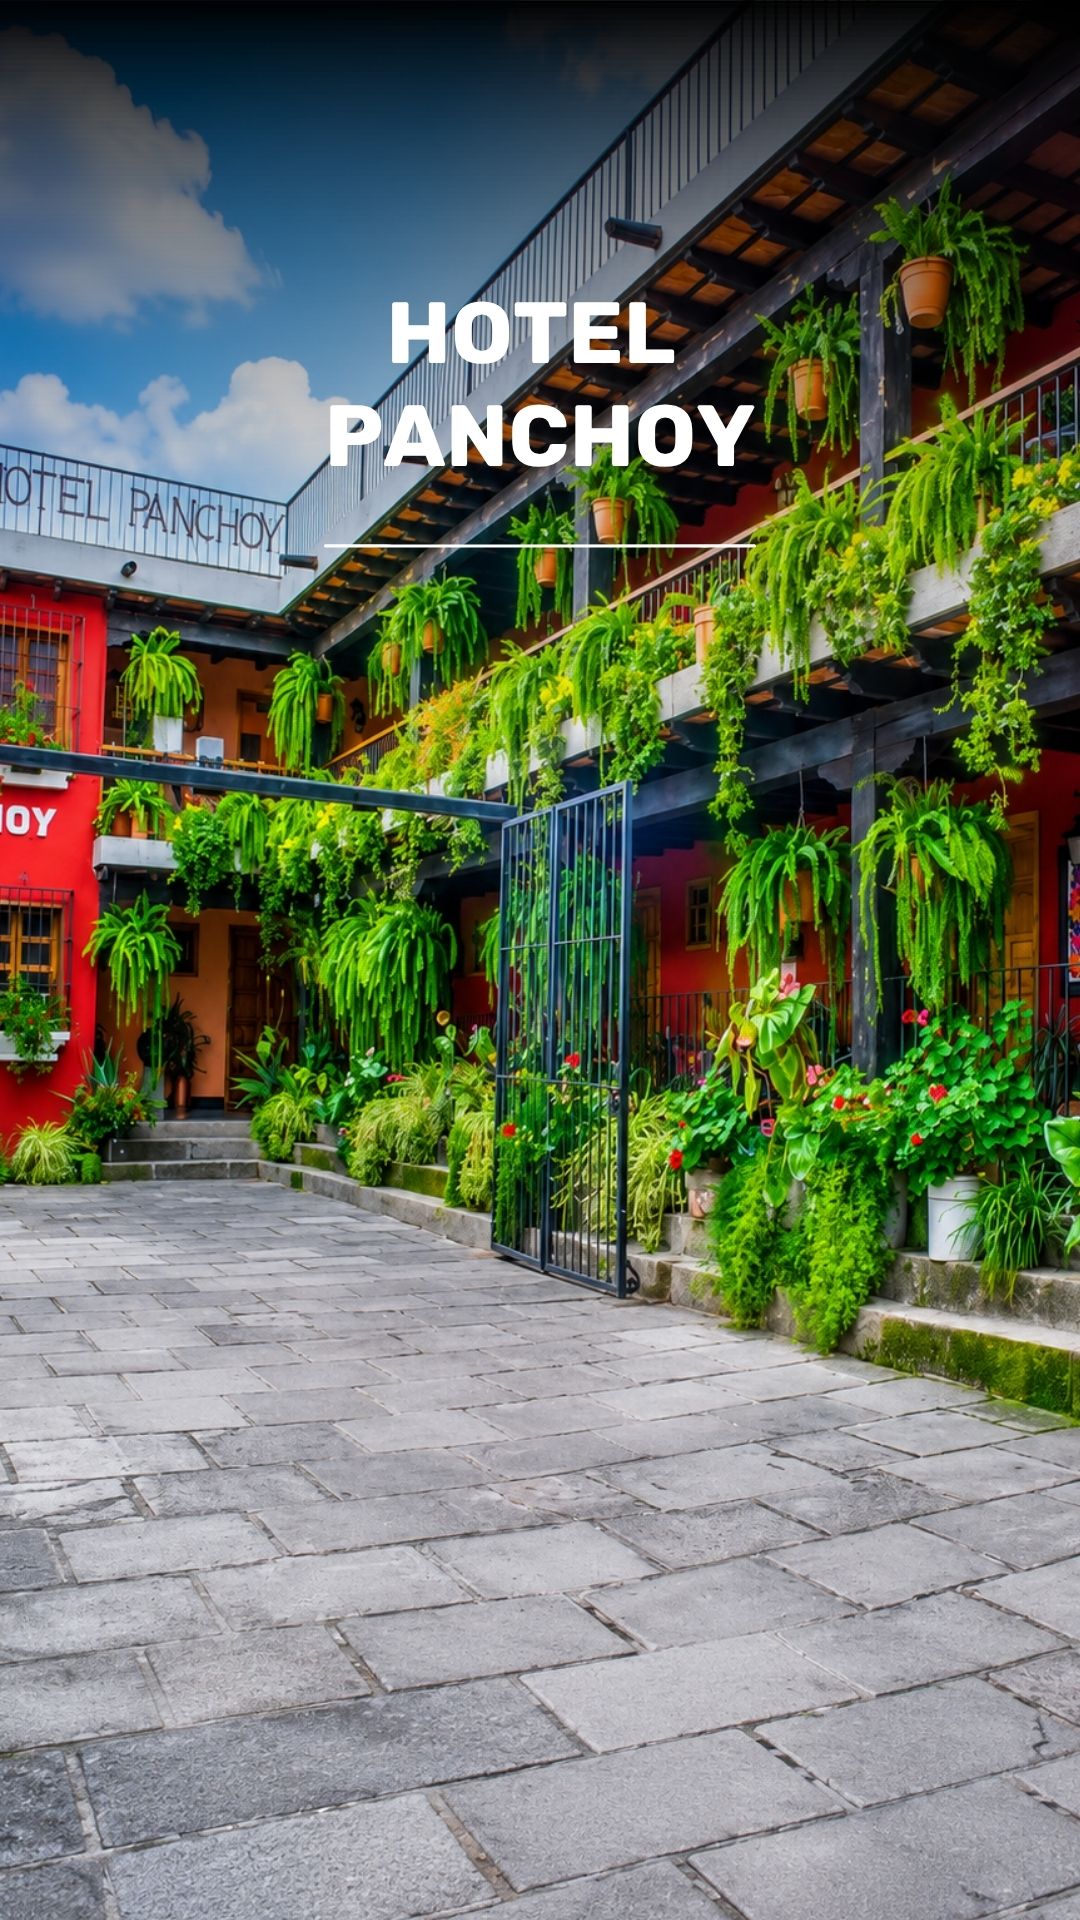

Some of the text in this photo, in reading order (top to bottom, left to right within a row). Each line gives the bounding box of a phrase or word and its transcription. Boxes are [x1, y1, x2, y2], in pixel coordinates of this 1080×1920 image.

[0, 462, 284, 552] OTEL PANCHOY
[0, 804, 57, 837] OY
